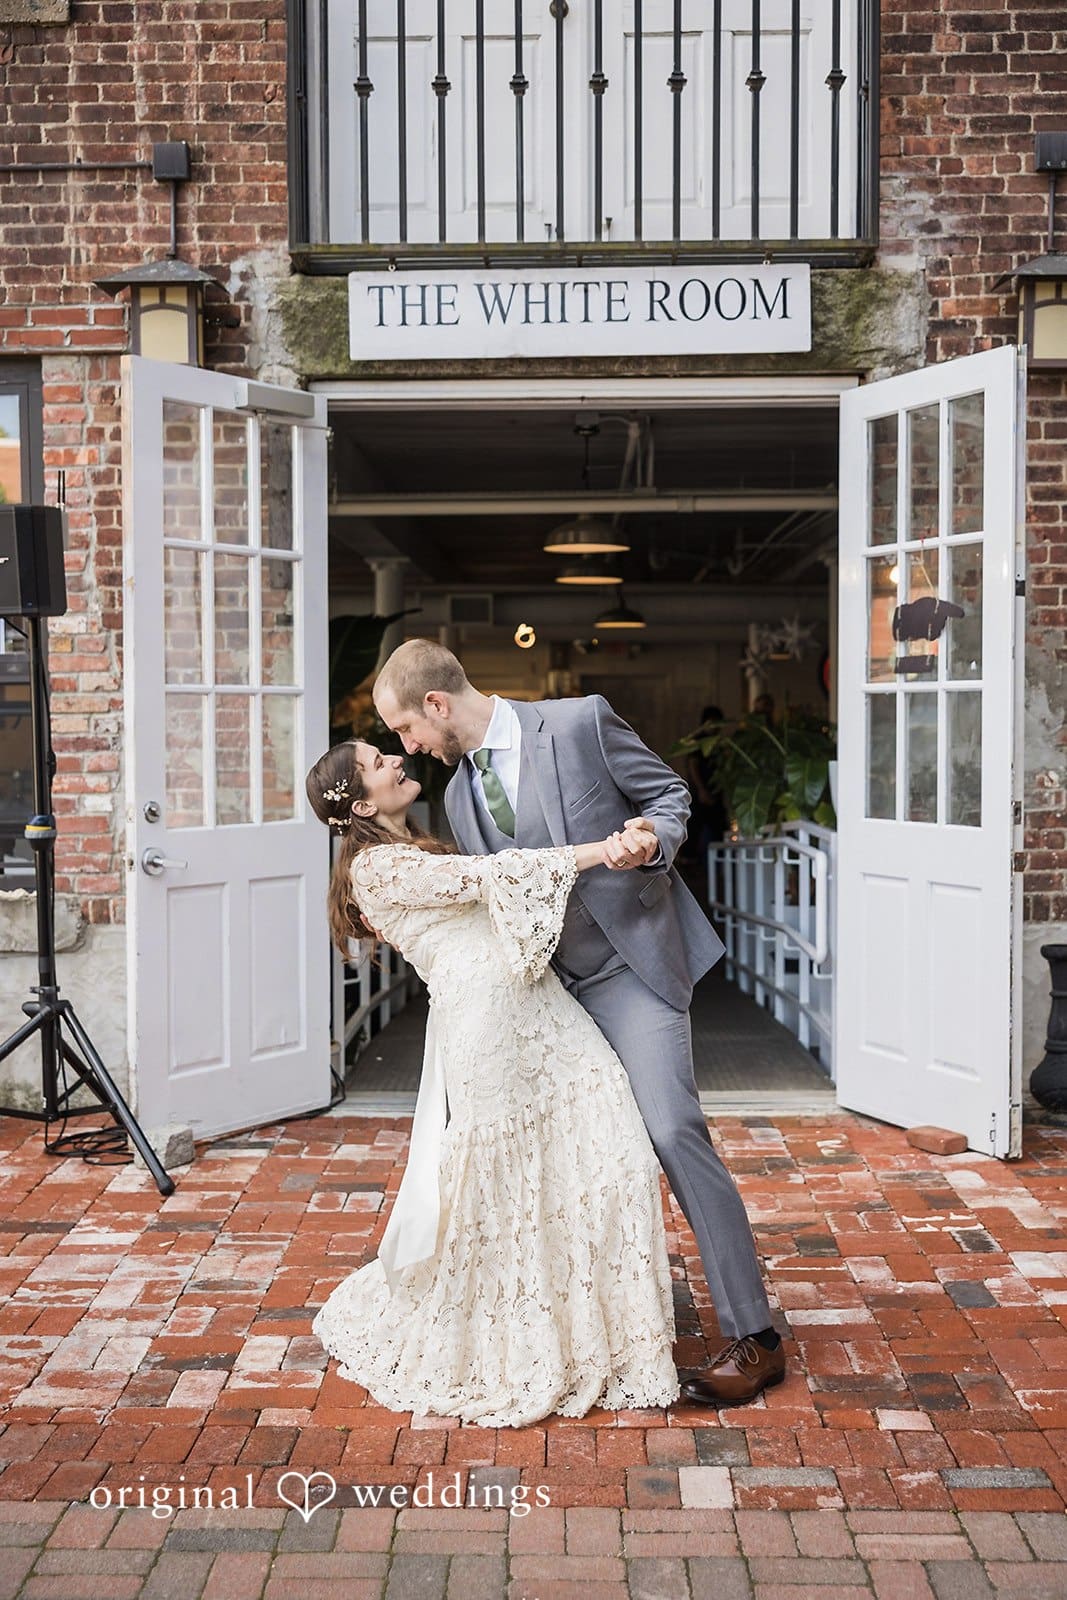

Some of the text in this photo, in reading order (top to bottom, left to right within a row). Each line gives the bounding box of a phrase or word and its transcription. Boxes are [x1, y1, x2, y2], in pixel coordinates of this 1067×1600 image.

[367, 277, 793, 327] THE WHITE ROOM
